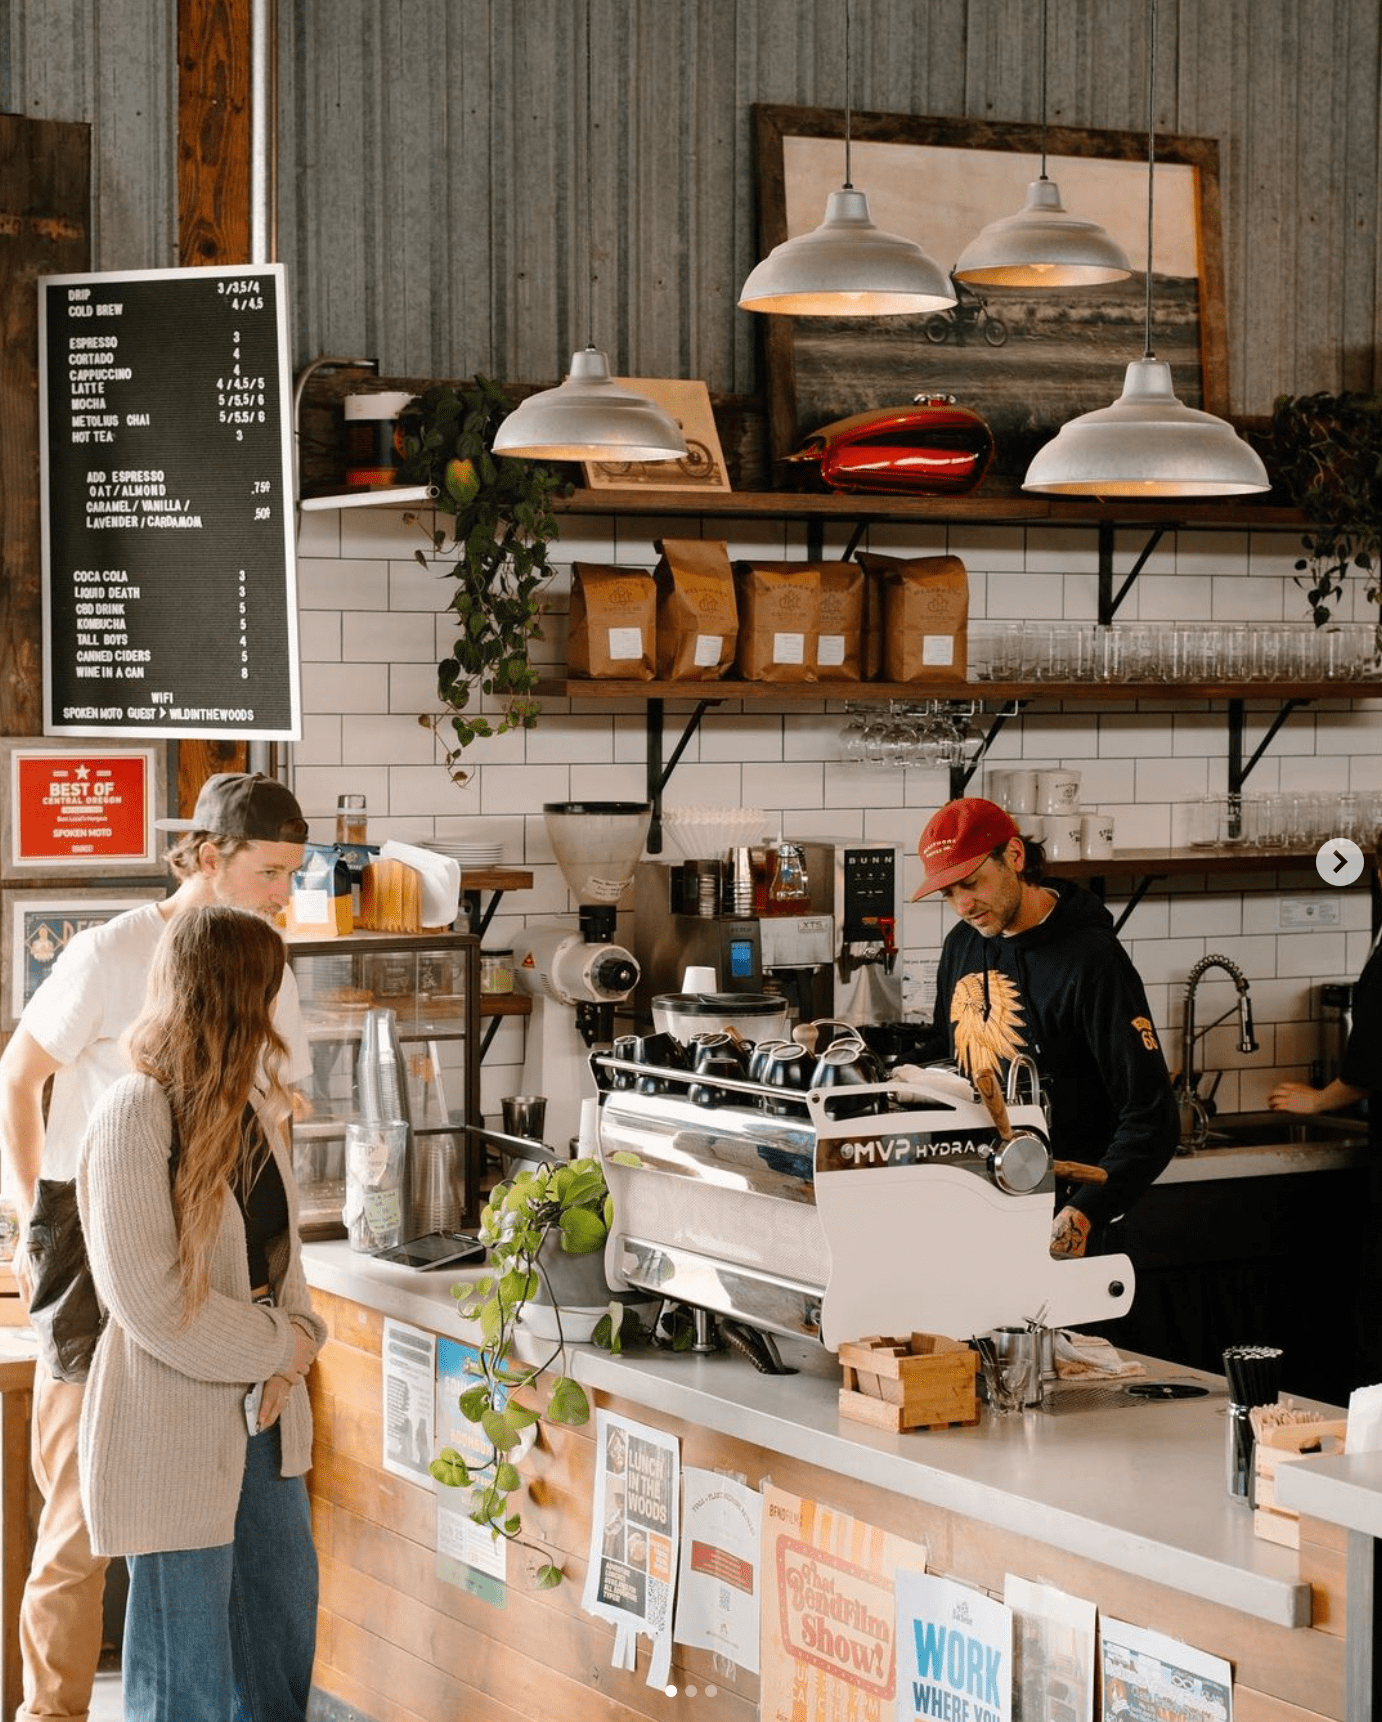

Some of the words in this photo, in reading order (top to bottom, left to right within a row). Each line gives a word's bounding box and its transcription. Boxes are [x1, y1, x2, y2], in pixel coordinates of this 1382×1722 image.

[68, 289, 91, 301] DRIP
[68, 305, 93, 317] COLD
[96, 304, 123, 315] BREW
[69, 336, 118, 349] ESPRESSO
[233, 331, 240, 343] 3
[68, 352, 114, 365] CORTADO
[233, 347, 240, 359] 4
[69, 368, 132, 381] CAPPUCCINO
[233, 364, 240, 376] 4
[71, 382, 105, 394] LATTE
[71, 398, 106, 410] MOCHA
[72, 415, 119, 427] METOLIUS
[127, 414, 150, 426] CHAI
[72, 431, 90, 443] HOT
[93, 430, 114, 442] TEA
[236, 429, 243, 441] 3
[87, 471, 106, 483] ADD
[112, 470, 164, 482] ESPRESSO
[74, 571, 100, 582] COCA
[103, 571, 128, 582] COLA
[239, 570, 246, 582] 3
[75, 587, 104, 599] LIQUID
[108, 587, 140, 598] DEATH
[239, 586, 246, 598] 3
[76, 603, 94, 615] CBD
[96, 603, 125, 614] DRINK
[239, 602, 246, 614] 5
[77, 619, 126, 630] KOMBUCHA
[239, 619, 247, 630] 5
[77, 634, 99, 645] TALL
[104, 634, 128, 645] BOYS
[239, 635, 247, 647] 4
[77, 651, 113, 662] CANNED
[115, 650, 151, 662] CIDERS
[241, 650, 248, 662] 5
[76, 666, 100, 678] WINE
[102, 667, 113, 678] IN
[116, 667, 123, 678] A
[125, 667, 144, 678] CAN
[151, 692, 173, 704] WIFI
[63, 707, 98, 720] SPOKEN
[100, 708, 122, 719] MOTO
[127, 708, 156, 719] GUEST
[49, 782, 90, 797] BEST
[93, 781, 115, 796] OF
[42, 796, 83, 805] CENTRAL
[854, 1138, 911, 1164] MVP
[916, 1140, 976, 1158] HYDRA
[629, 1448, 664, 1480] LUNCH
[628, 1470, 639, 1492] IN
[640, 1476, 661, 1501] THE
[628, 1491, 668, 1525] WOODS
[802, 1613, 884, 1679] Show!
[912, 1617, 1001, 1711] WORK
[912, 1681, 969, 1722] WHERE
